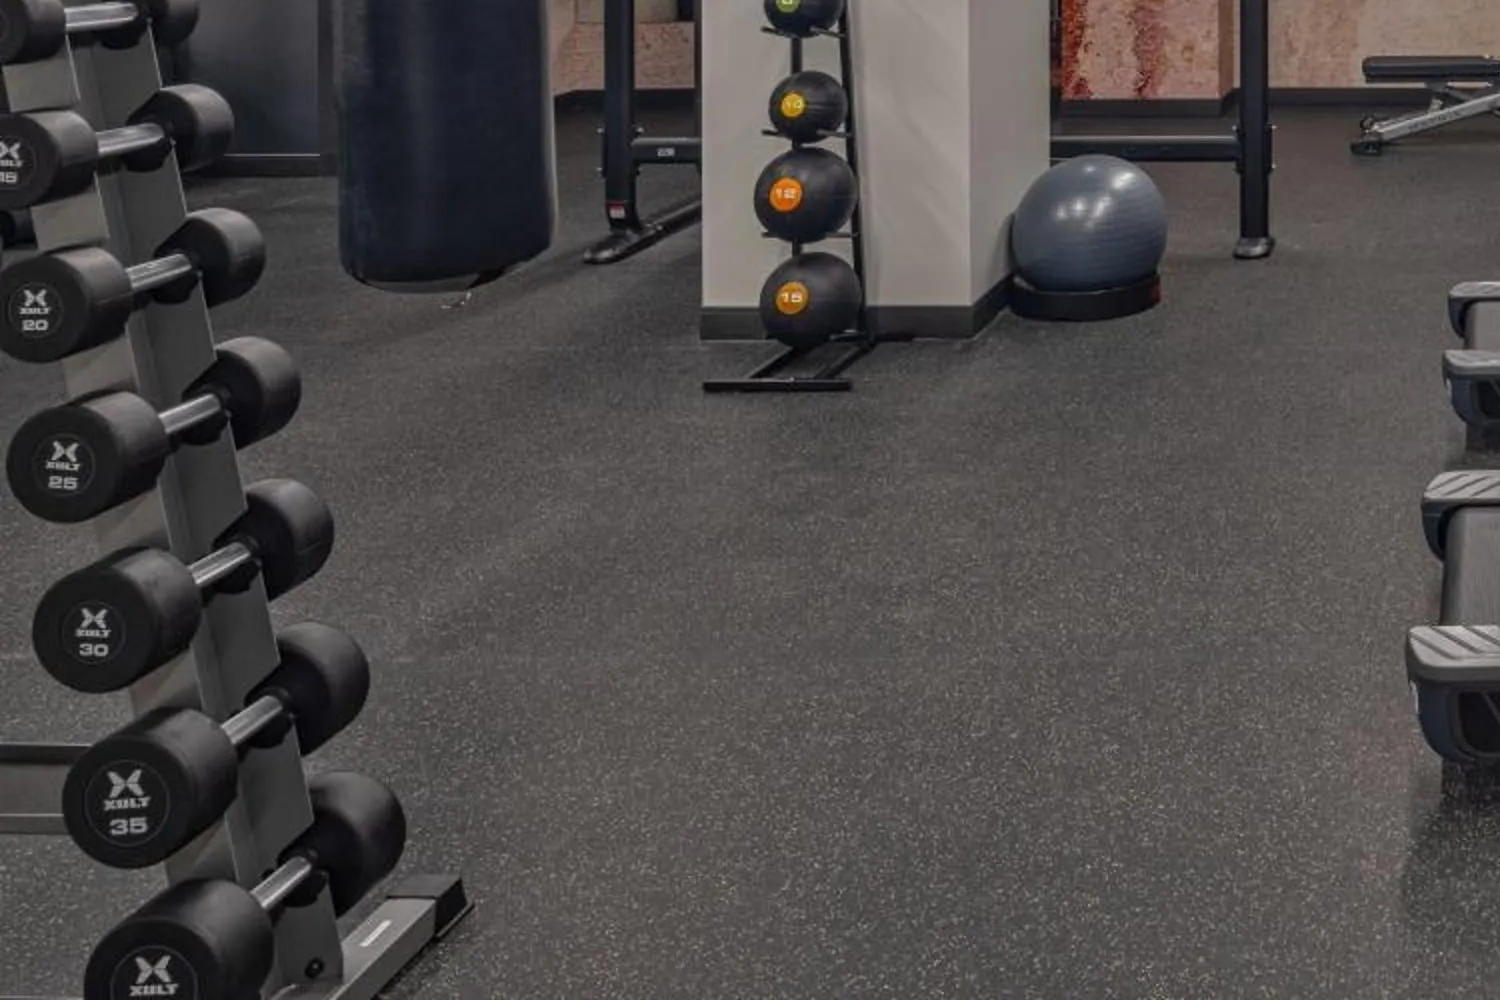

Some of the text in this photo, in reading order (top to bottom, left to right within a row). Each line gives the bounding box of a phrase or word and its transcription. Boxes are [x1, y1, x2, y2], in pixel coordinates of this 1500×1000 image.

[22, 319, 49, 331] 20
[48, 475, 78, 490] 25
[79, 643, 109, 657] 30
[109, 816, 148, 836] 35
